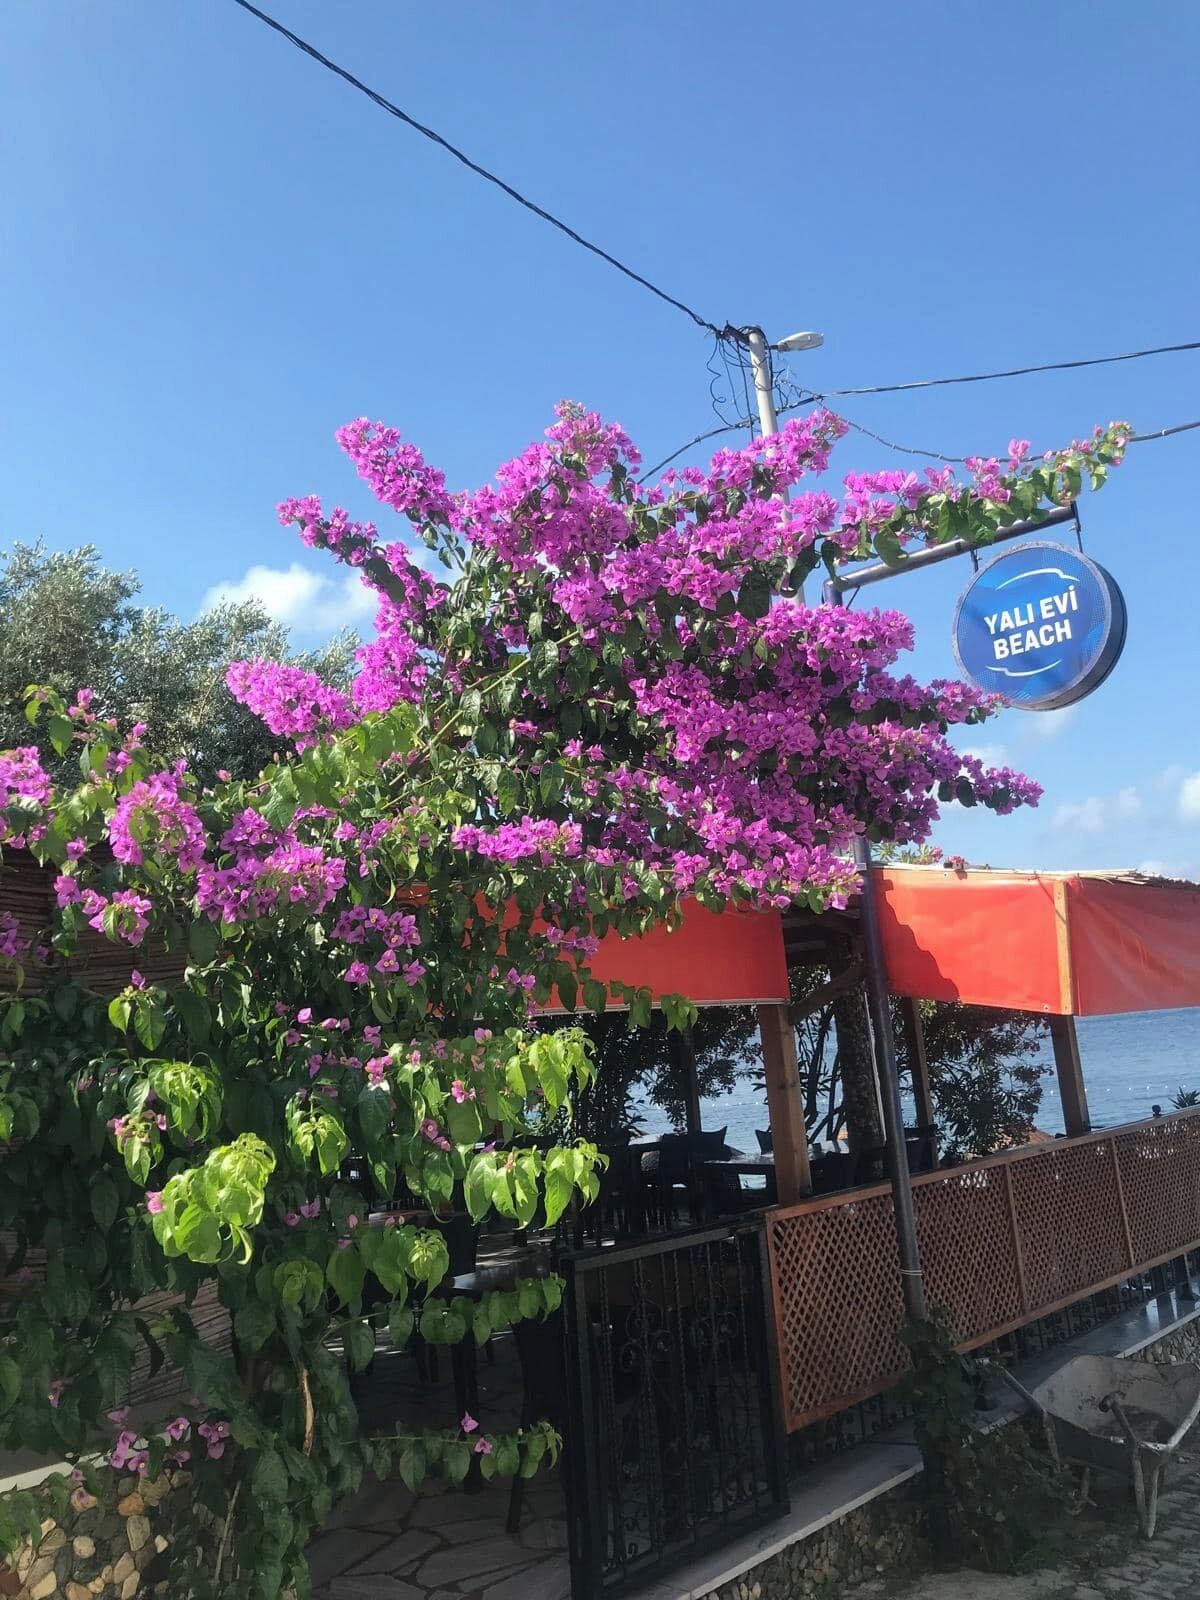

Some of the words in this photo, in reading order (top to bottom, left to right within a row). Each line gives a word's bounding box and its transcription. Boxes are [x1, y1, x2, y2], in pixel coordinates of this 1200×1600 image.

[984, 603, 1034, 634] YALI
[1039, 585, 1078, 619] EVİ
[993, 619, 1072, 659] BEACH
